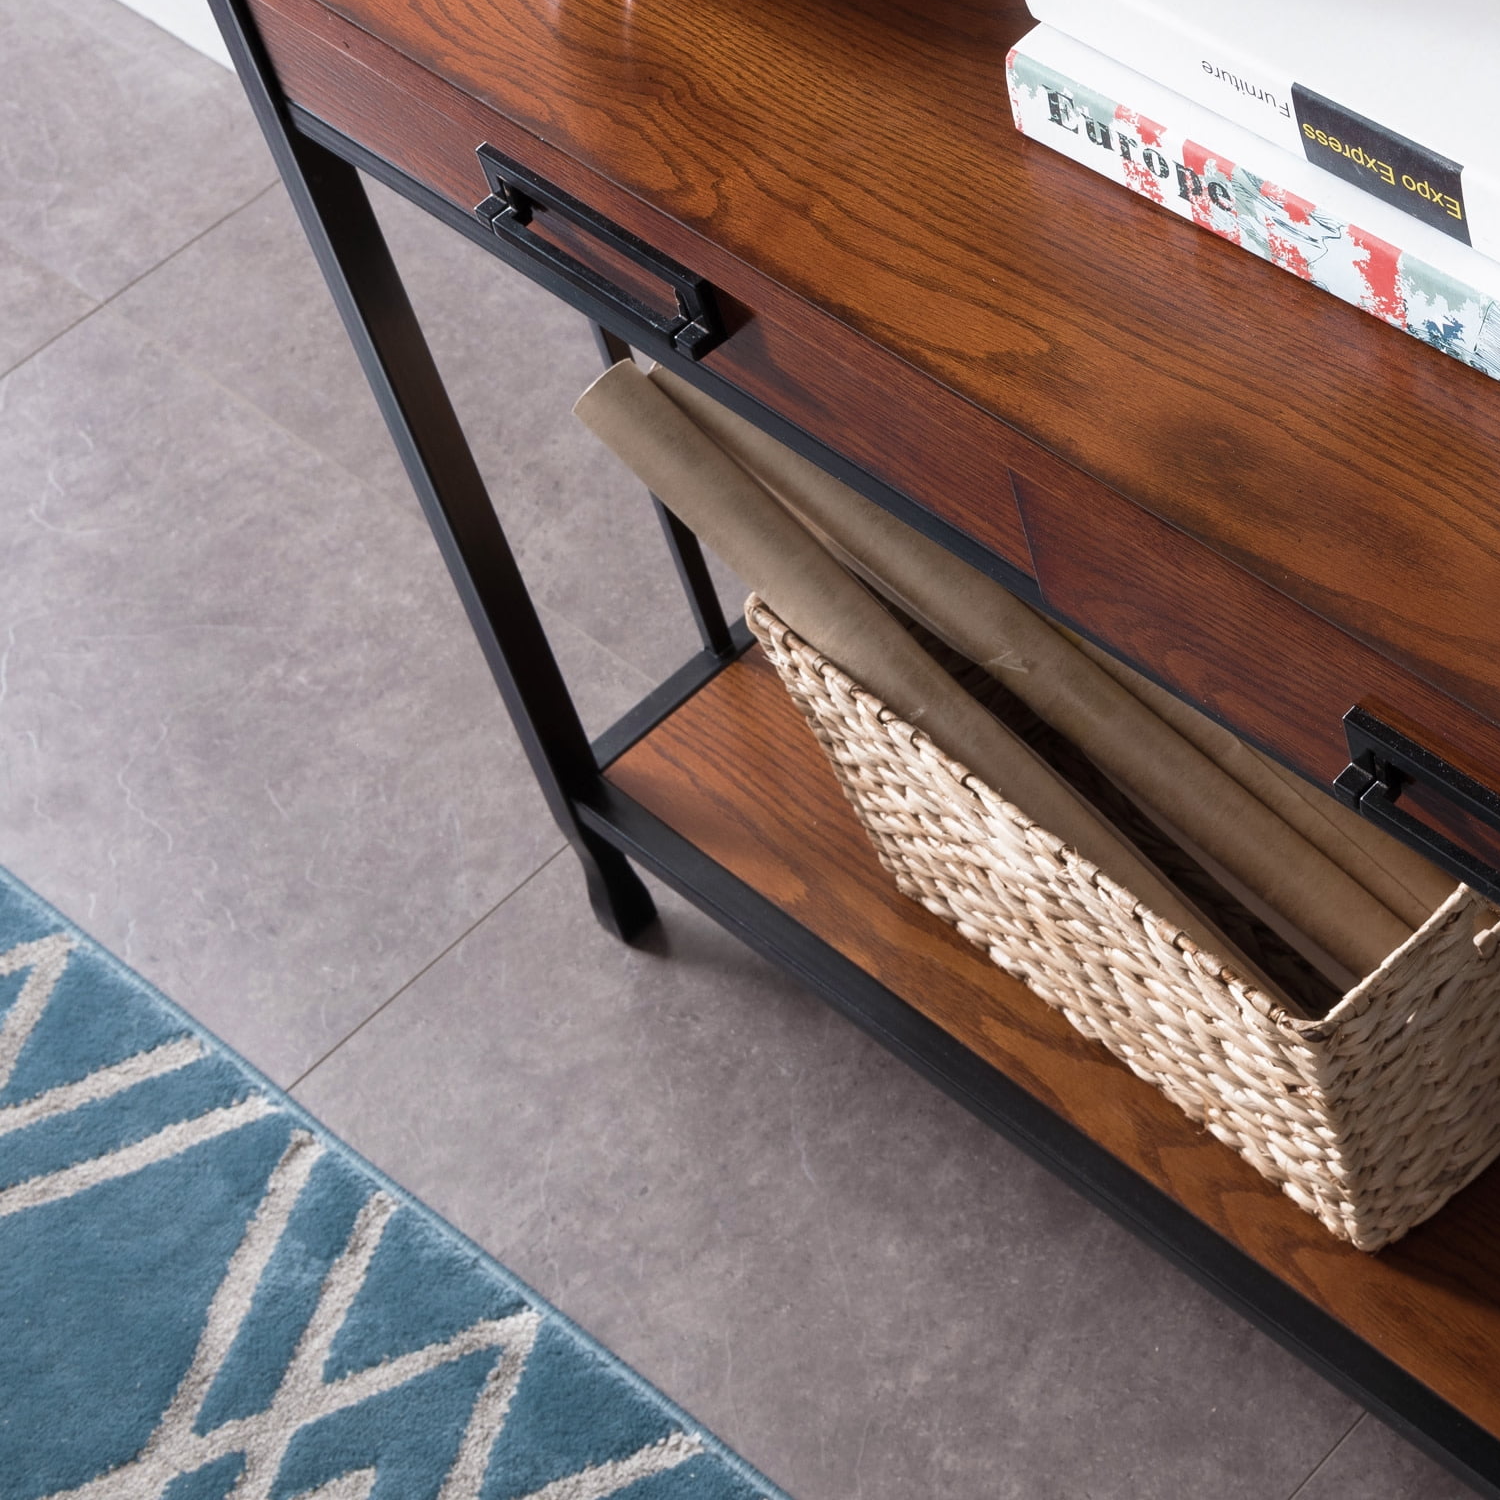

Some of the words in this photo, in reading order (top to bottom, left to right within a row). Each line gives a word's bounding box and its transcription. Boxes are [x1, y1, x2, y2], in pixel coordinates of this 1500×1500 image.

[1201, 59, 1291, 118] Furniture
[1042, 85, 1234, 212] Europe
[1303, 123, 1395, 186] Express
[1402, 172, 1463, 220] Expo
